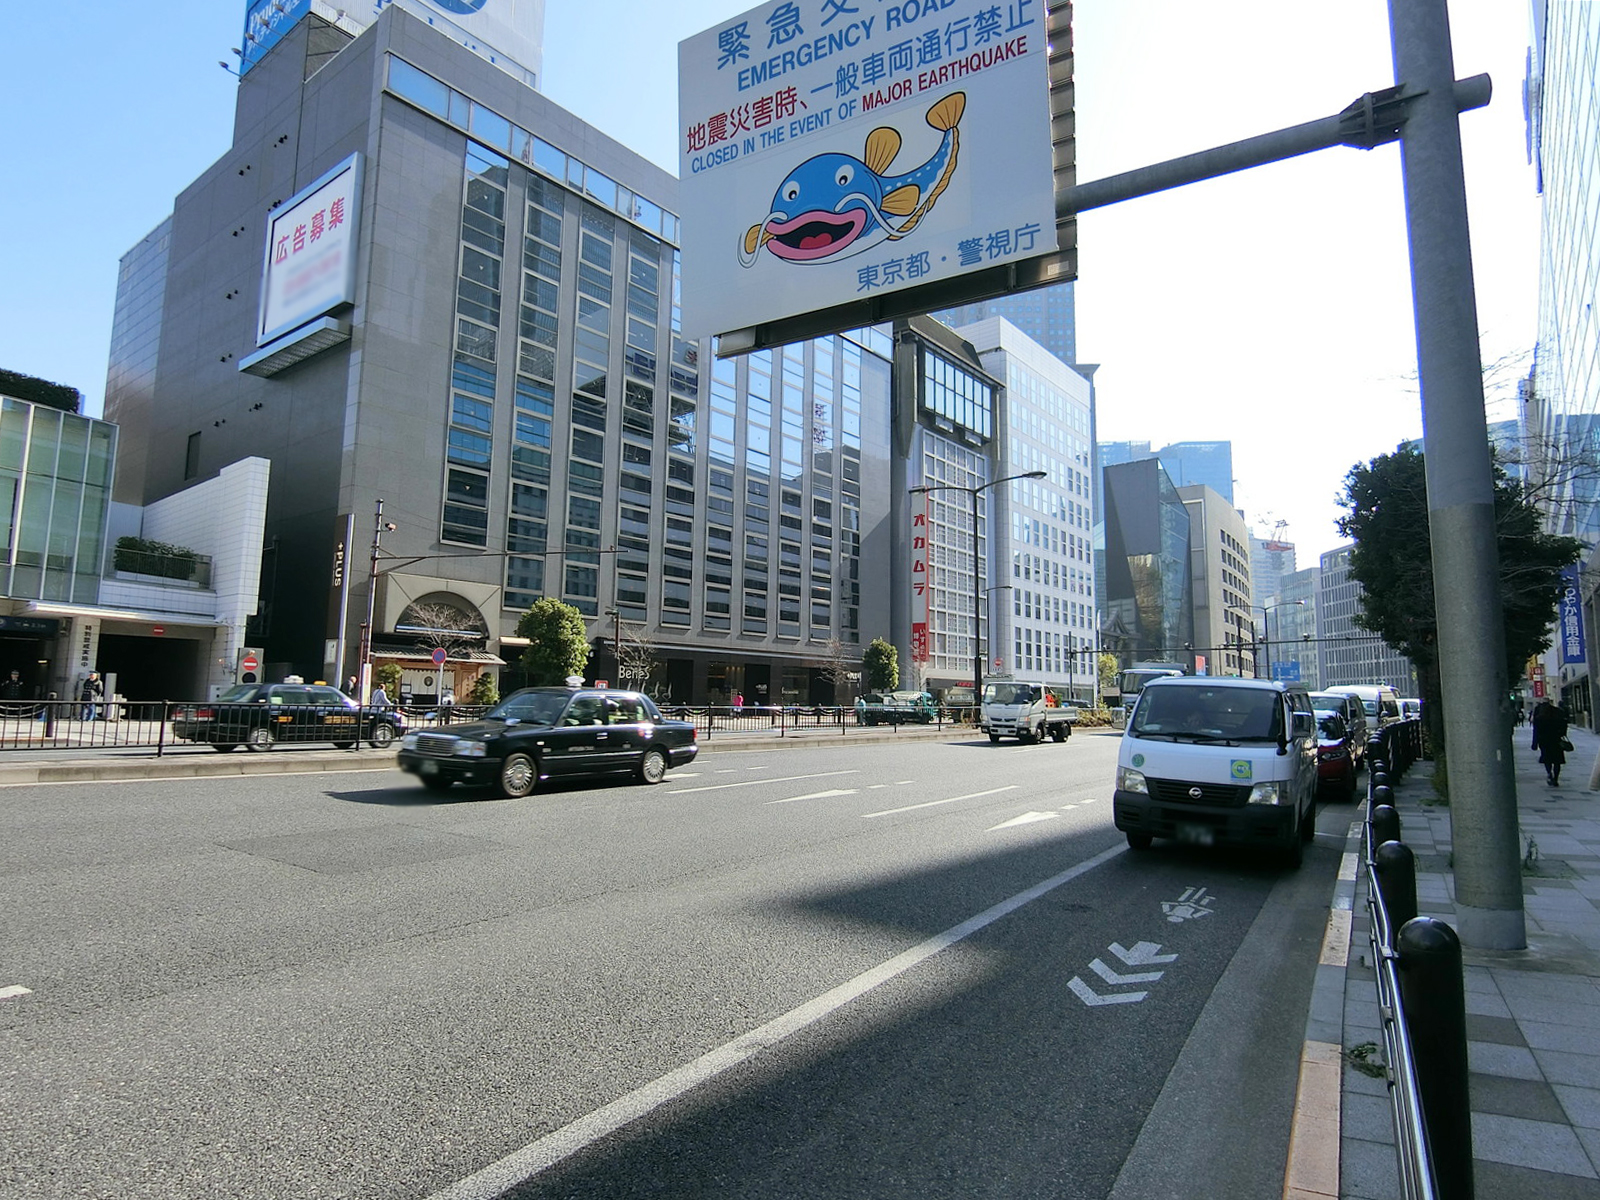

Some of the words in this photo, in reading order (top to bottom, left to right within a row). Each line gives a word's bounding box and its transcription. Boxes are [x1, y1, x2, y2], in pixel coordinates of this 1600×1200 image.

[716, 0, 884, 71] 緊急交
[737, 15, 876, 92] EMERGENCY
[691, 143, 739, 174] CLOSED
[743, 136, 755, 154] IN
[760, 125, 785, 149] THE
[789, 107, 833, 139] EVENT
[838, 98, 858, 121] OF
[862, 78, 913, 112] MAJOR
[918, 35, 1029, 92] EARTHQUAKE
[274, 196, 346, 265] 広告募集
[856, 222, 1042, 292] 東京都・警視庁
[912, 513, 926, 596] オカムラ
